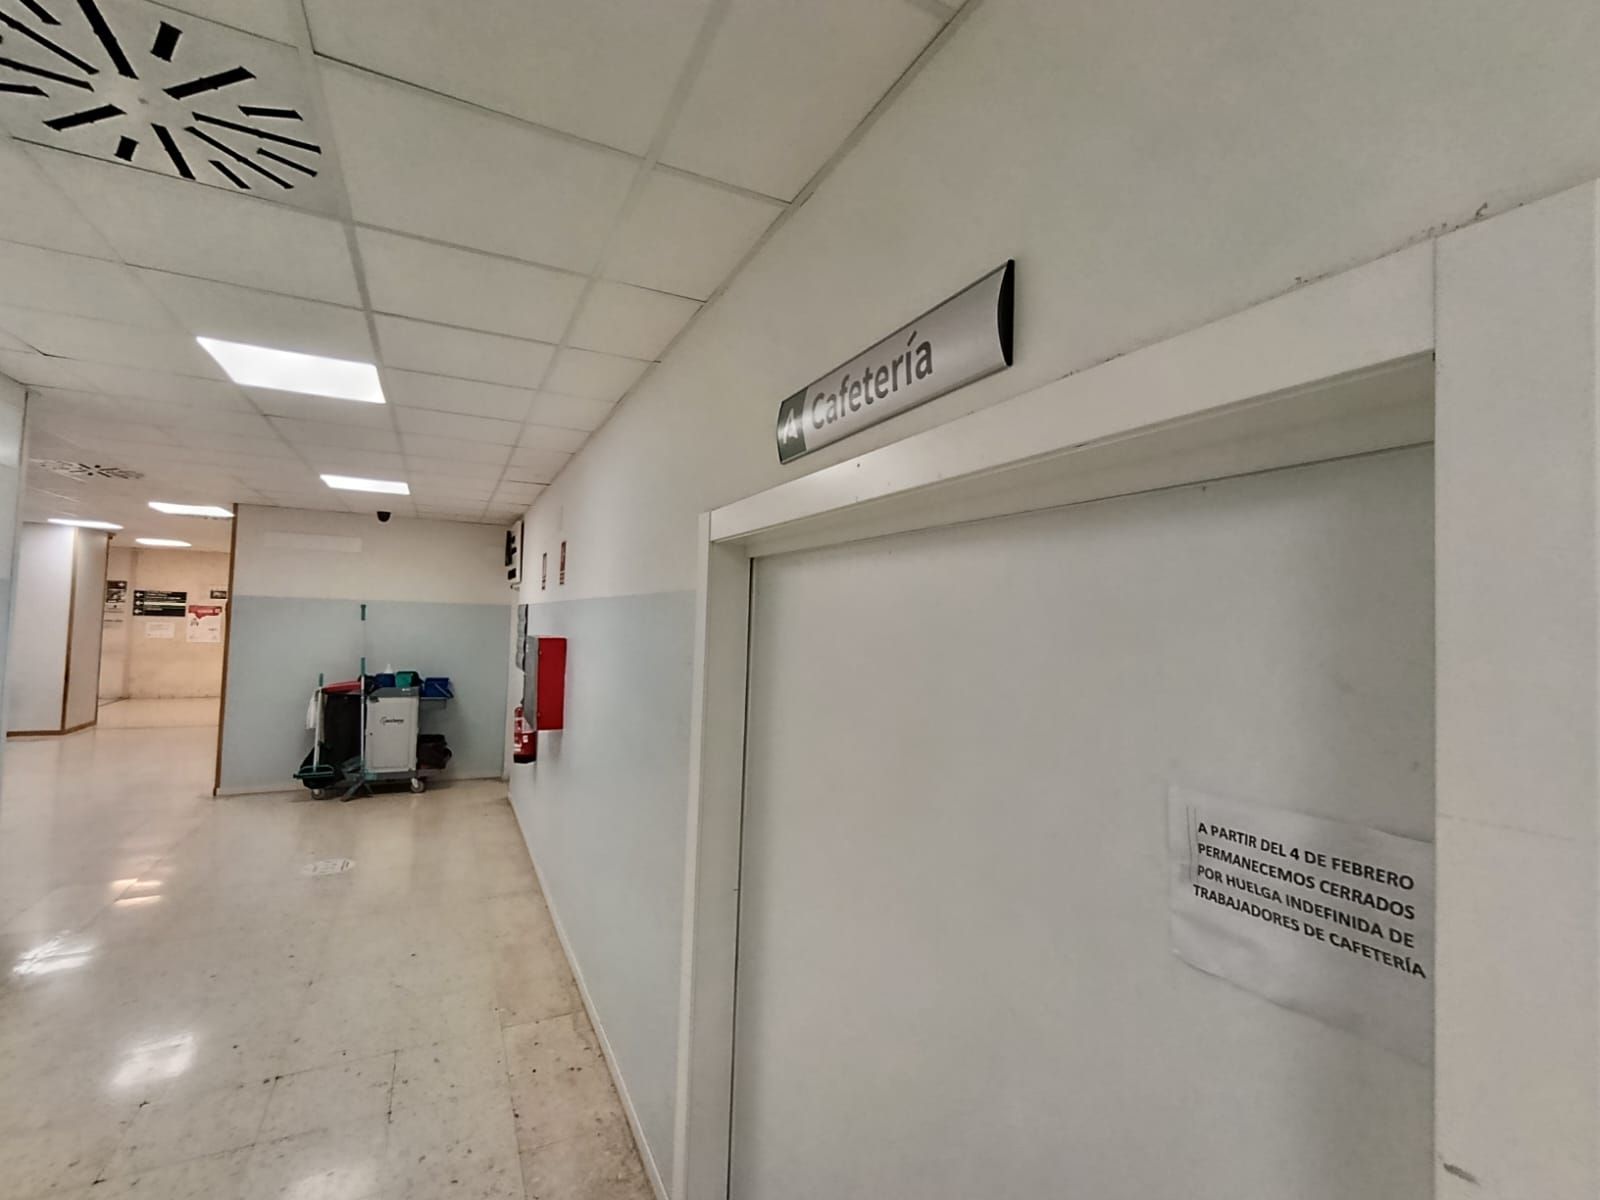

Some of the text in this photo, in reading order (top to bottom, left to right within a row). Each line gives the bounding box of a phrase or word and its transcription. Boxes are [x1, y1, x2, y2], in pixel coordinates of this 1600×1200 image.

[812, 331, 933, 430] Cafetería
[1198, 822, 1415, 890] A PARTIR DEL 4 DE FEBRERO
[1198, 843, 1415, 920] PERMANECEMOS CERRADOS
[1193, 884, 1426, 979] TRABAJADORES DE CAFETERÍA
[1198, 865, 1415, 948] POR HUELGA INDEFINIDA DE
